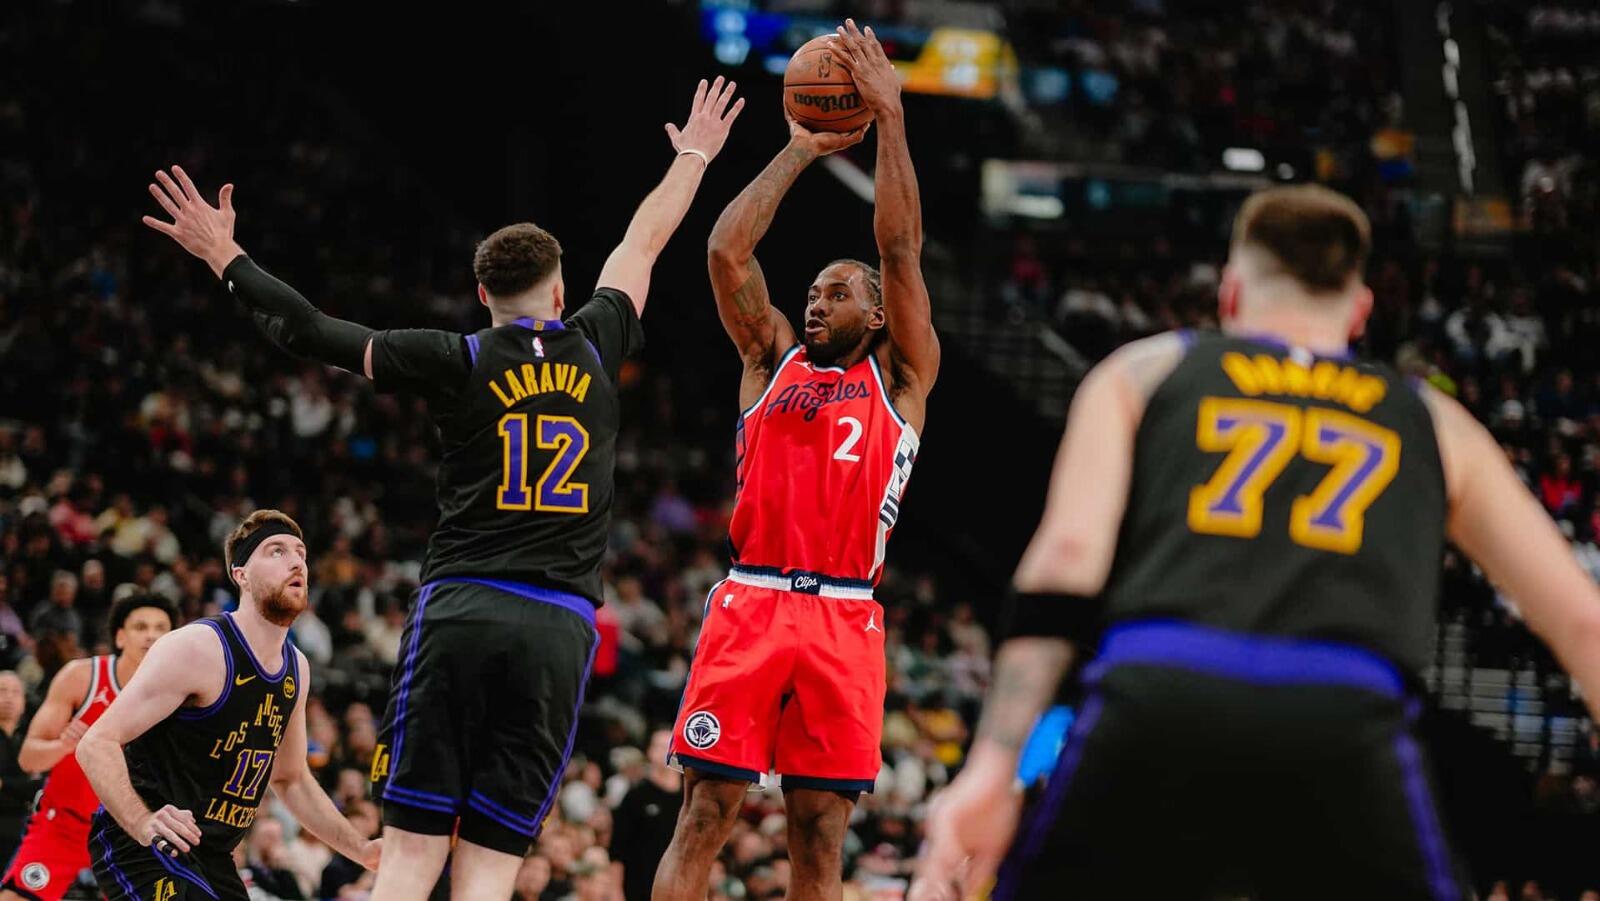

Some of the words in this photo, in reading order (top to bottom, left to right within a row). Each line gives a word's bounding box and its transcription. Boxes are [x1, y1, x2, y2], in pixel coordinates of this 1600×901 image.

[794, 92, 861, 113] Wilson
[488, 362, 592, 408] LARAVIA
[496, 412, 590, 514] 12
[833, 416, 863, 463] 2
[1187, 395, 1402, 555] 77
[794, 575, 818, 590] Clips
[209, 721, 249, 759] LOS
[254, 693, 284, 747] ANGEL
[222, 748, 274, 800] 17
